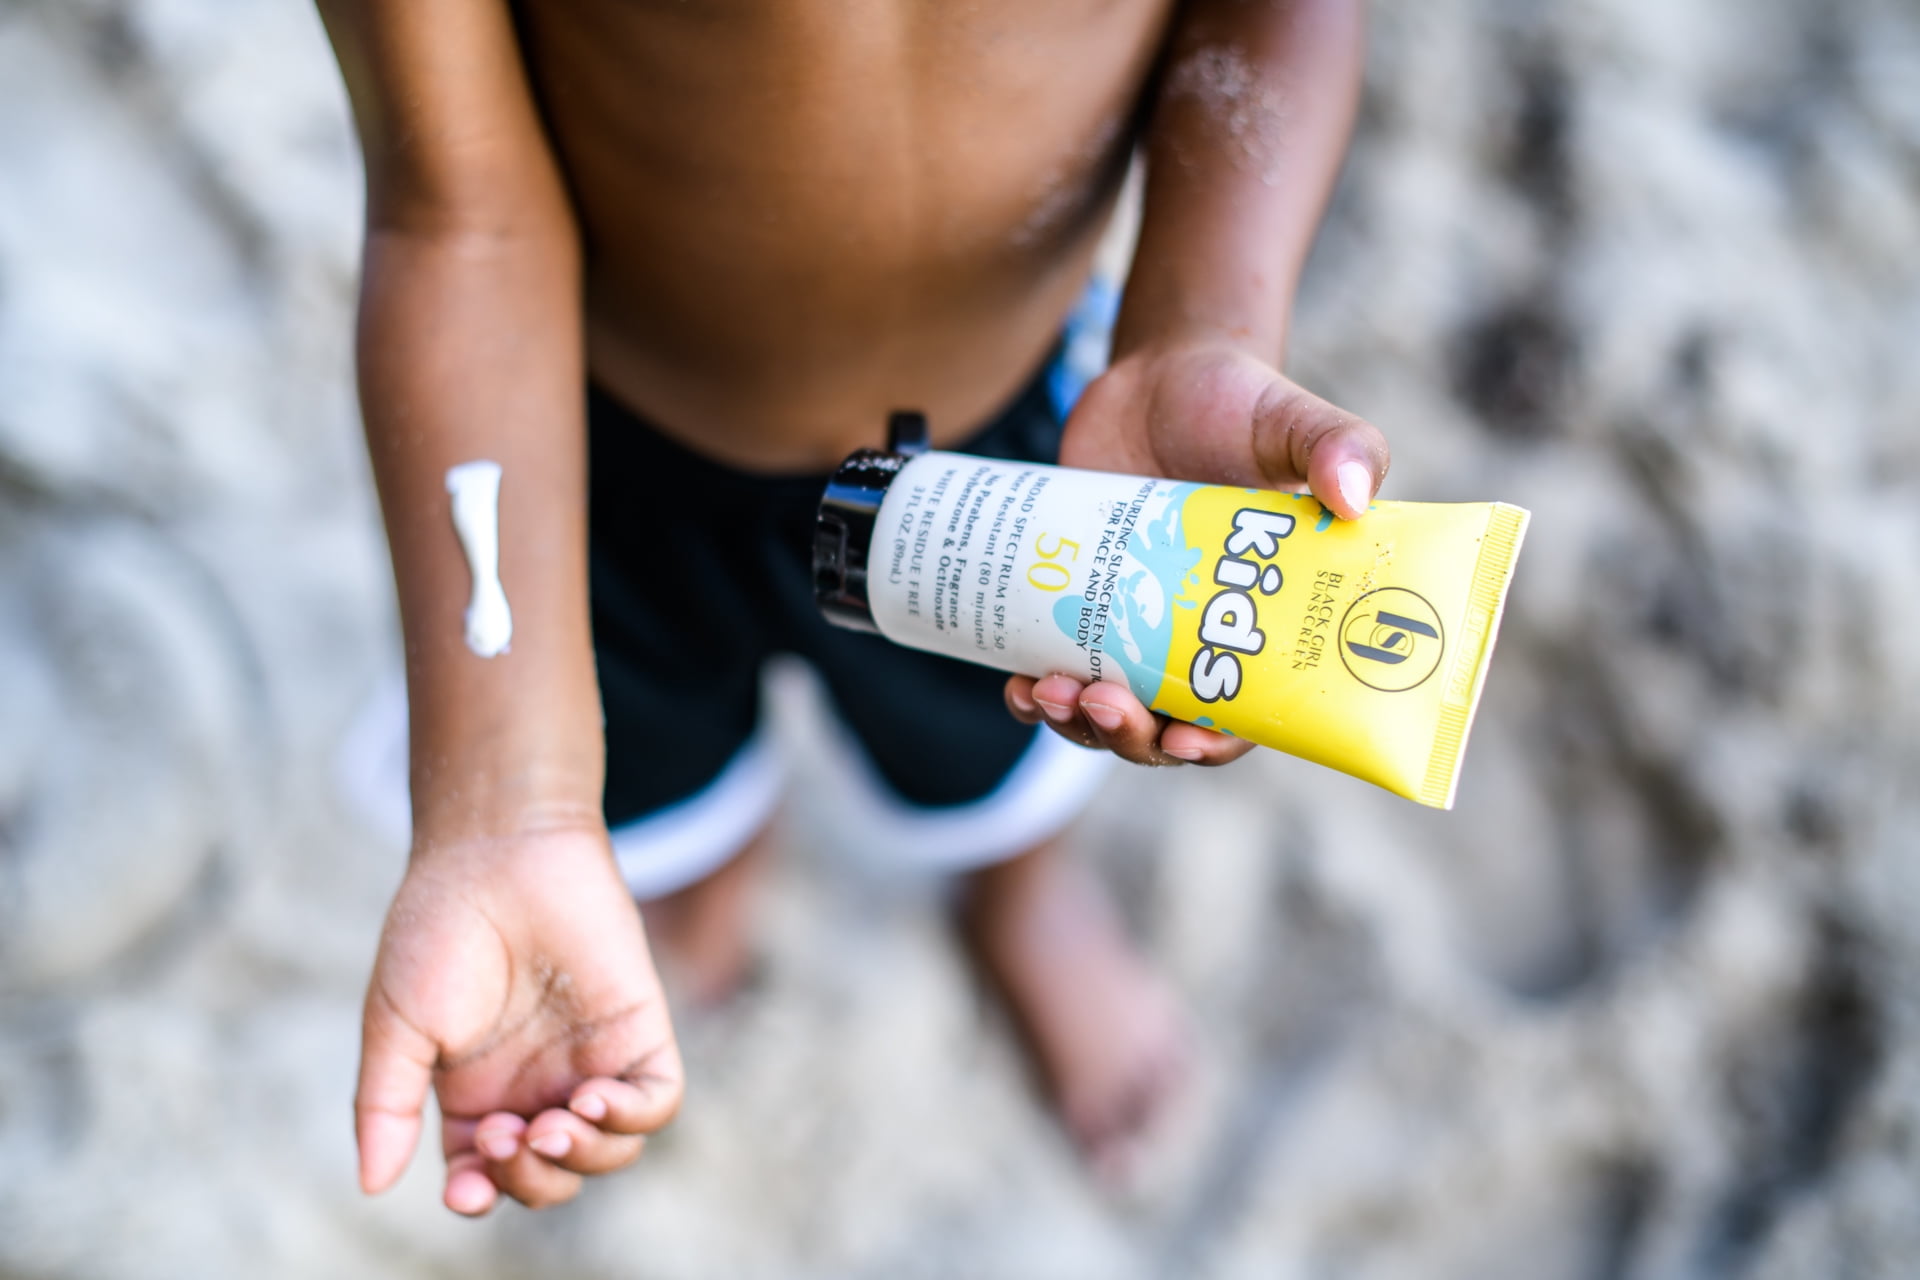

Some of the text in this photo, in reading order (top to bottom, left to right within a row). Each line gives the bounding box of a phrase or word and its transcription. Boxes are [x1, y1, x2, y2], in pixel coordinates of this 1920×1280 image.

[907, 495, 921, 511] FL
[984, 496, 1016, 556] Resistant
[1021, 476, 1050, 513] BROAD
[908, 469, 956, 616] WHITE RESIDUE FREE
[934, 466, 990, 630] Oxybenzone & Octinoxate
[949, 474, 1002, 629] No Parabens, Fragrance
[978, 561, 992, 585] (80
[996, 517, 1027, 598] SPECTRUM
[1027, 532, 1080, 592] 50
[1076, 501, 1128, 652] FOR FACE AND BODY
[975, 591, 988, 650] minutes)
[1093, 554, 1122, 646] SUNSCREEN
[1189, 508, 1296, 703] kids
[1291, 570, 1328, 670] SUNSCREEN
[1306, 573, 1344, 669] BLACK GIRL
[1090, 648, 1102, 682] LOTI
